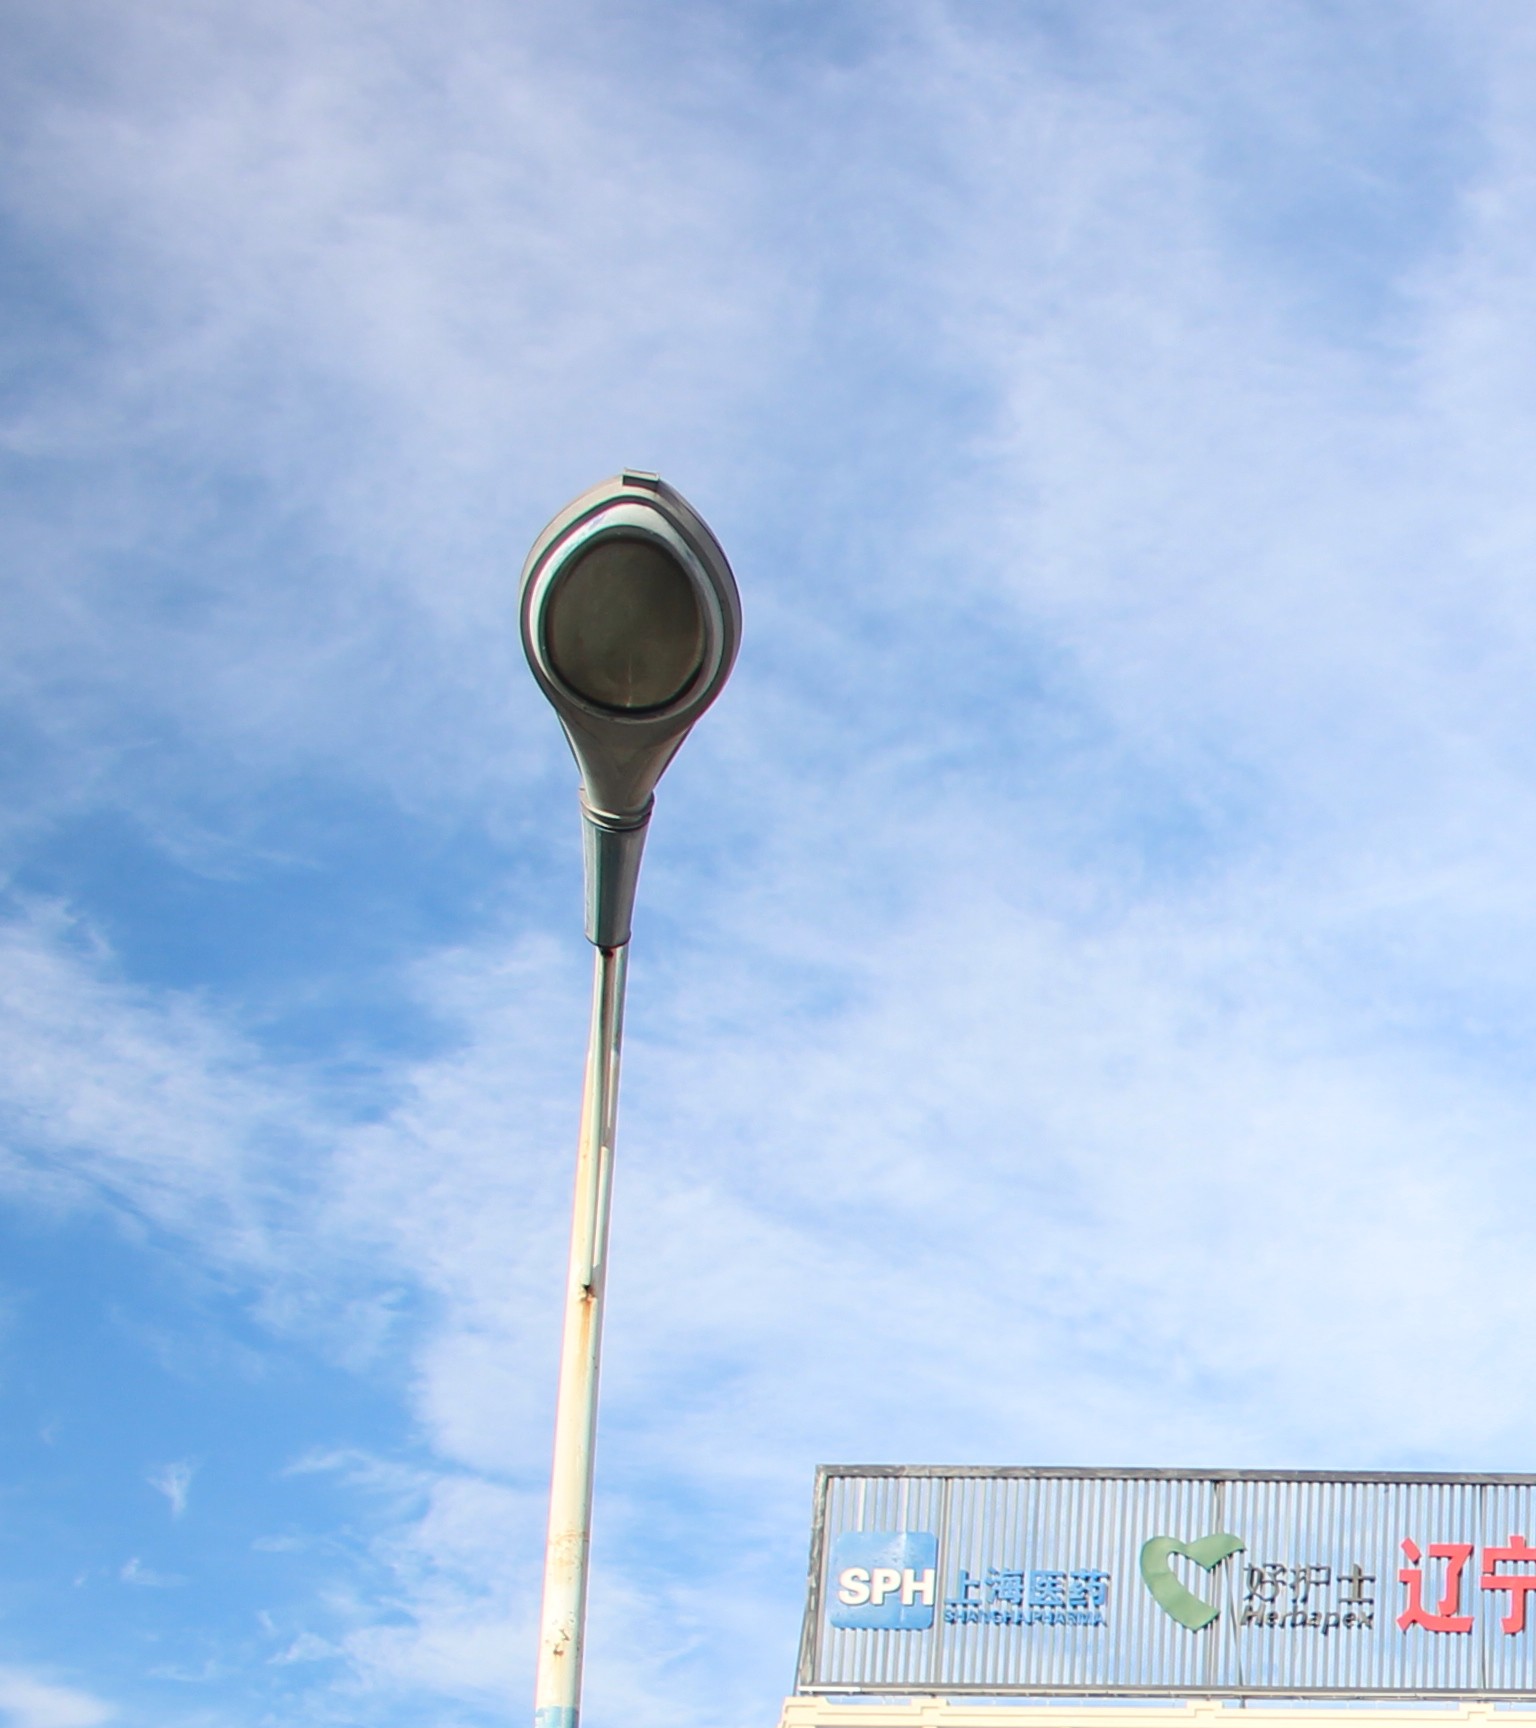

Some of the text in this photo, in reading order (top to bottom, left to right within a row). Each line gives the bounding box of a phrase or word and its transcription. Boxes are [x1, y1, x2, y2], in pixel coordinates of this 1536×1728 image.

[838, 1567, 935, 1606] SPH
[944, 1568, 1110, 1607] 上海医药
[1243, 1563, 1376, 1604] 好护士
